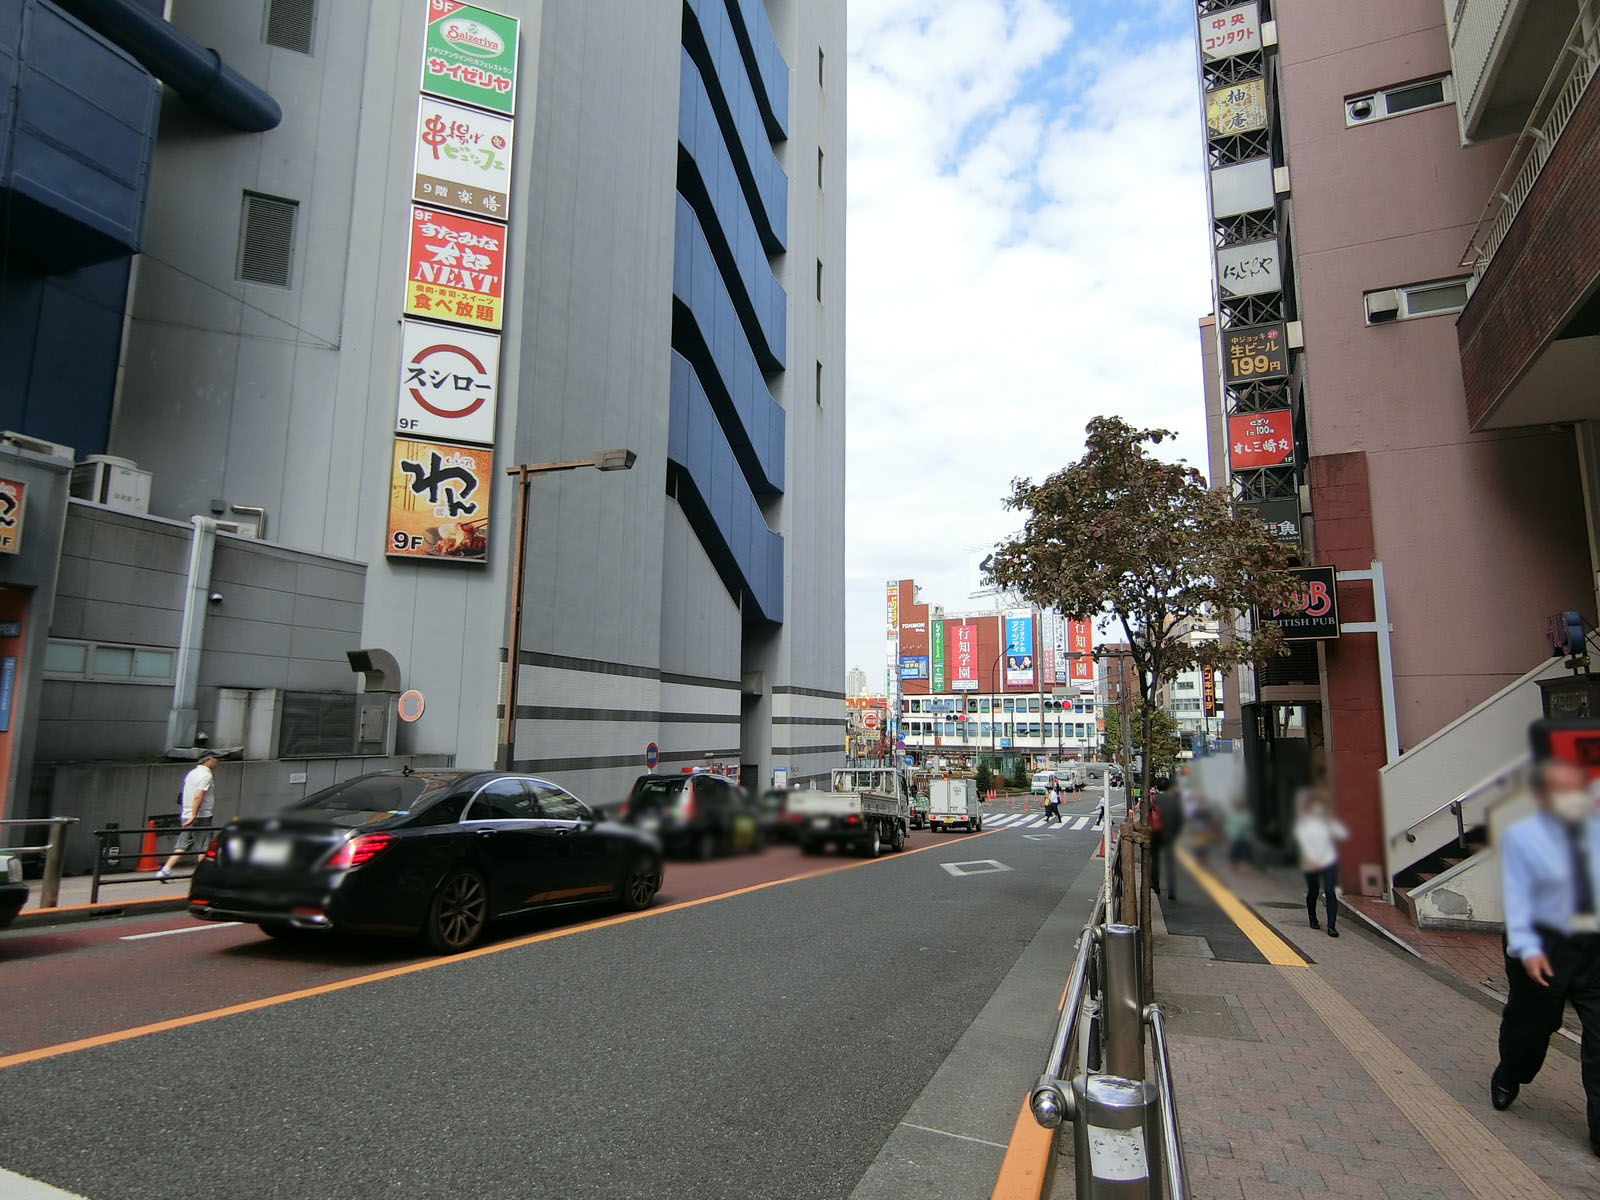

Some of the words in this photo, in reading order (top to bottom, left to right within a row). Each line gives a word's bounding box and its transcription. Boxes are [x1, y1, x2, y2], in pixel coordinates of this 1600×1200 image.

[431, 0, 455, 13] 9F
[1211, 13, 1245, 30] 中央
[446, 25, 500, 50] Saizeriya
[1206, 28, 1254, 50] コンタクト
[428, 57, 511, 94] サイゼリヤ
[414, 210, 433, 221] 9F
[418, 223, 499, 251] すたみな
[414, 261, 498, 294] NEXT
[414, 294, 494, 322] 食べ放題
[1231, 333, 1266, 344] 中ジョッキ
[1230, 340, 1280, 359] 生ビール
[1231, 355, 1281, 376] 199円
[404, 367, 491, 392] スシロー
[399, 418, 419, 430] 9F
[401, 452, 477, 517] わん
[393, 531, 423, 550] 9F
[1313, 617, 1335, 625] PUB
[958, 627, 970, 679] 行知学園
